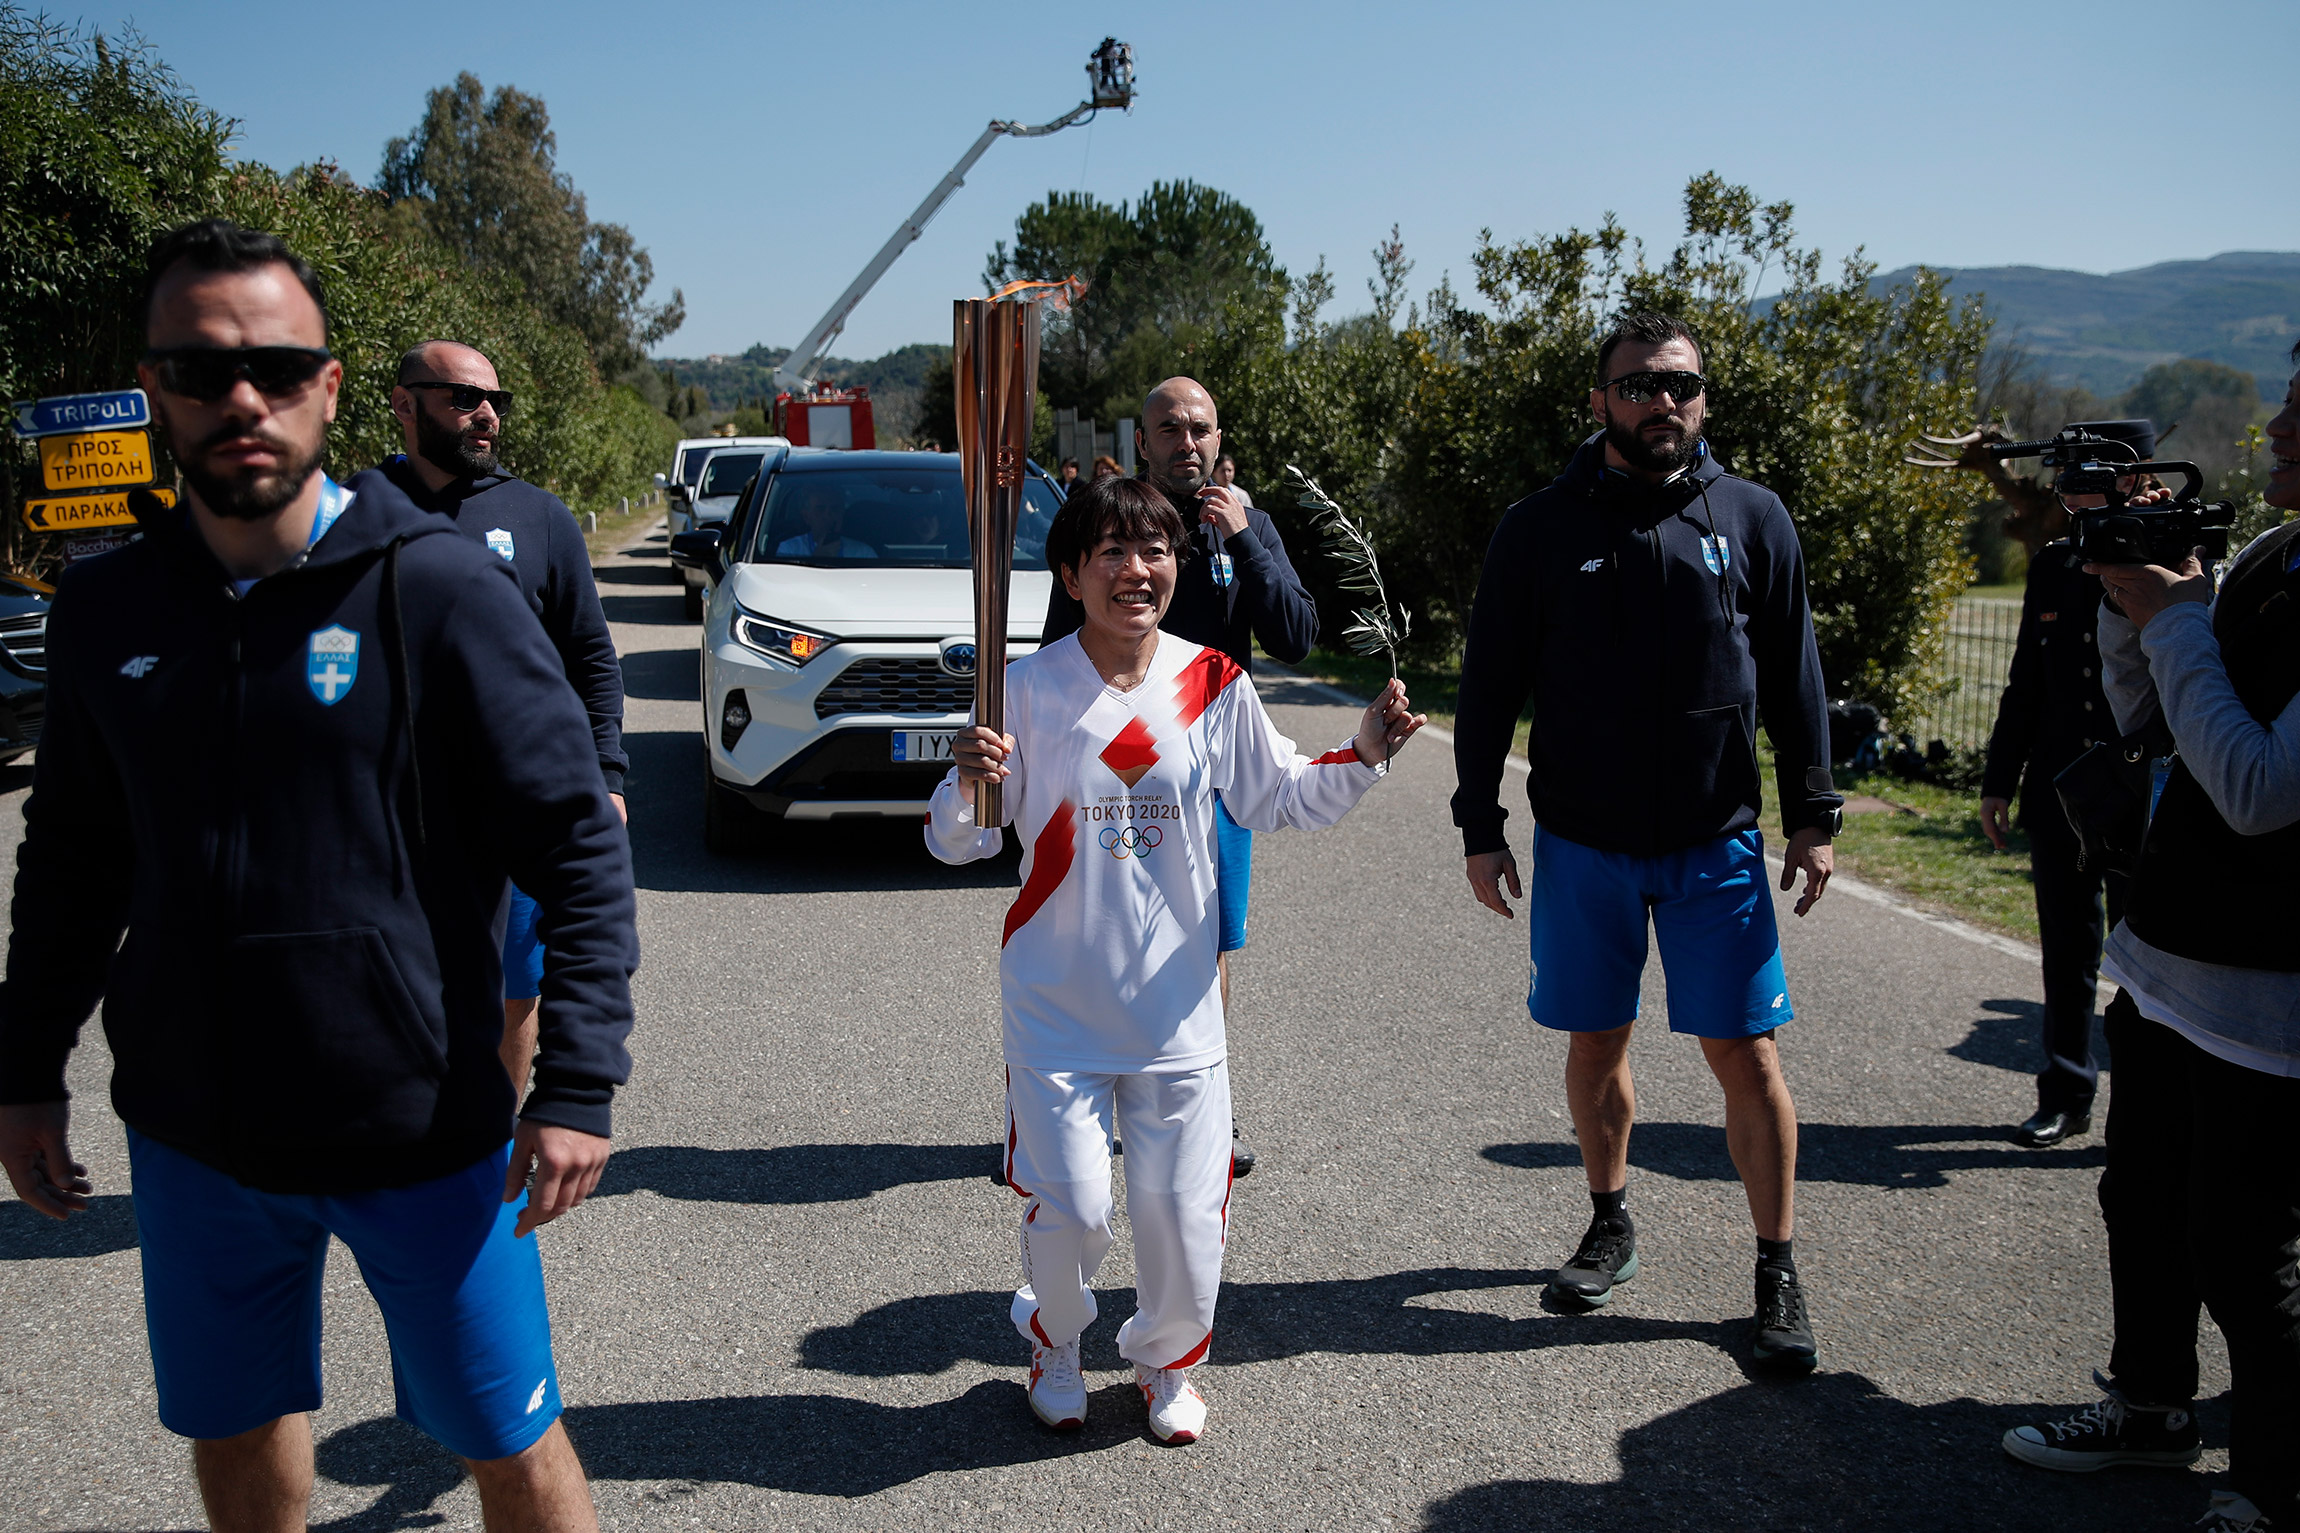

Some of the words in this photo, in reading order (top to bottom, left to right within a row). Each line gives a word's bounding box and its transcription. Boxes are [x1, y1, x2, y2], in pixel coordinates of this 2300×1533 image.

[51, 399, 137, 424] TRIPOLI
[68, 440, 123, 458] ΠΡΟΣ
[52, 461, 143, 482] ΤΡΙΠΟΛΗ
[1580, 559, 1604, 572] 4F
[120, 656, 159, 678] 4F
[316, 653, 351, 663] ΕΛΛΑΣ
[1081, 804, 1136, 822] TOKYO
[1139, 804, 1180, 820] 2020
[1771, 992, 1785, 1008] 4F
[525, 1377, 547, 1415] 4F
